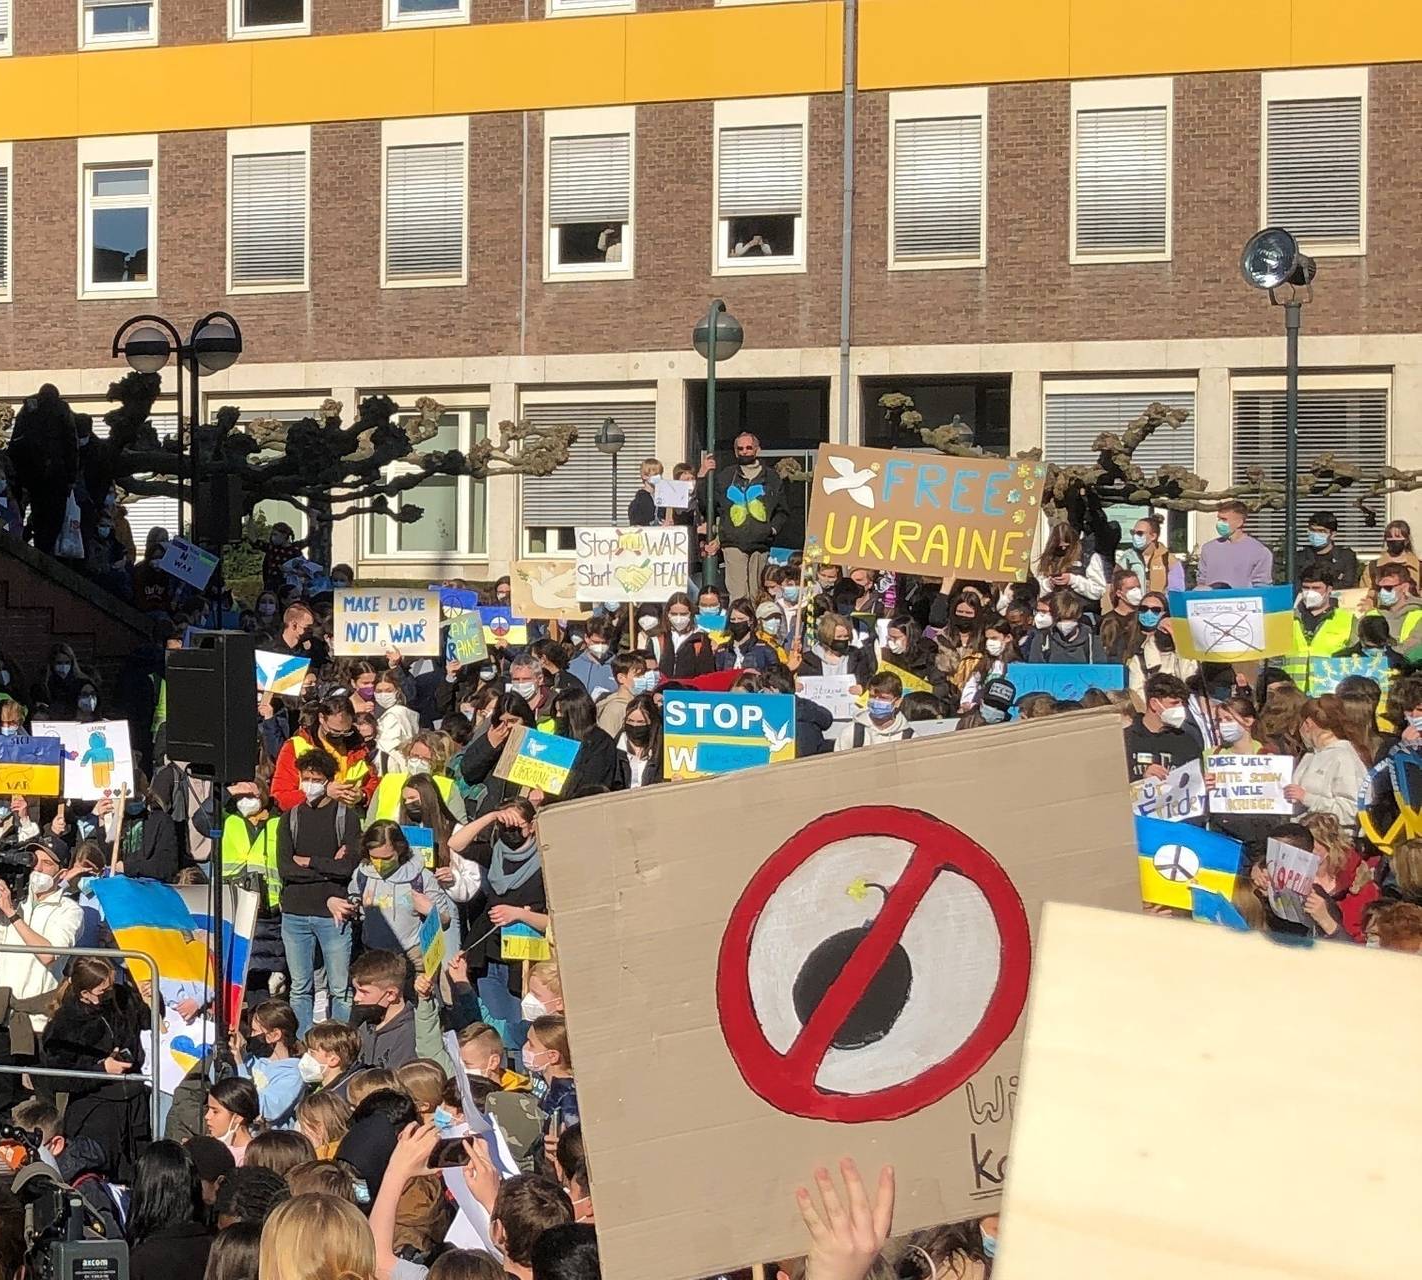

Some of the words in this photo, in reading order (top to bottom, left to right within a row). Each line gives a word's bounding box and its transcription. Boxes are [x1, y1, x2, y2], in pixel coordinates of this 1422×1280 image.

[881, 458, 1011, 517] FREE
[577, 531, 618, 561] Stop
[644, 531, 687, 557] WAR
[824, 511, 1024, 573] UKRAINE
[577, 563, 612, 587] Start
[653, 562, 687, 587] PEACE
[343, 596, 380, 612] MAKE
[389, 597, 426, 612] LOVE
[345, 622, 380, 643] NOT
[389, 622, 426, 643] WAR
[665, 700, 763, 730] STOP
[1208, 756, 1236, 768] DIESE
[1241, 757, 1272, 767] WELT
[1216, 771, 1243, 783] ATTE
[1213, 788, 1228, 798] ZU
[1233, 785, 1263, 796] VIELE
[1228, 798, 1275, 811] KRIEGE
